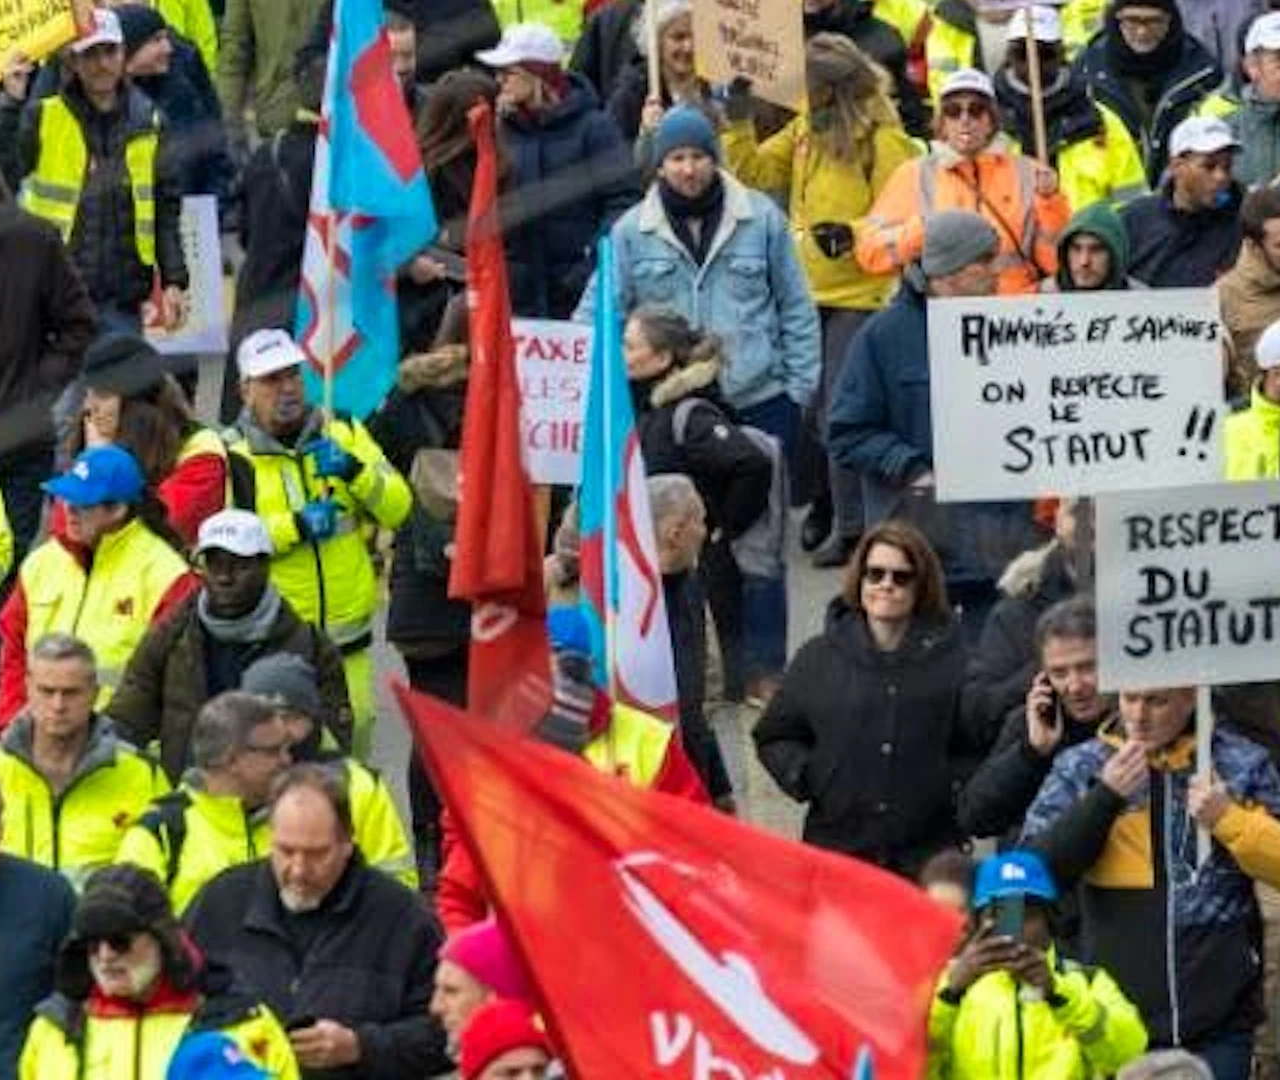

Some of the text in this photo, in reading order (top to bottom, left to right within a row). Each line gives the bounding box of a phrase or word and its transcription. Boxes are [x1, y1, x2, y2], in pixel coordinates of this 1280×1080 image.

[1087, 315, 1117, 343] ET
[982, 381, 1024, 403] ON
[1050, 404, 1081, 422] LE
[1003, 425, 1150, 472] STATUT
[1137, 566, 1210, 606] DU
